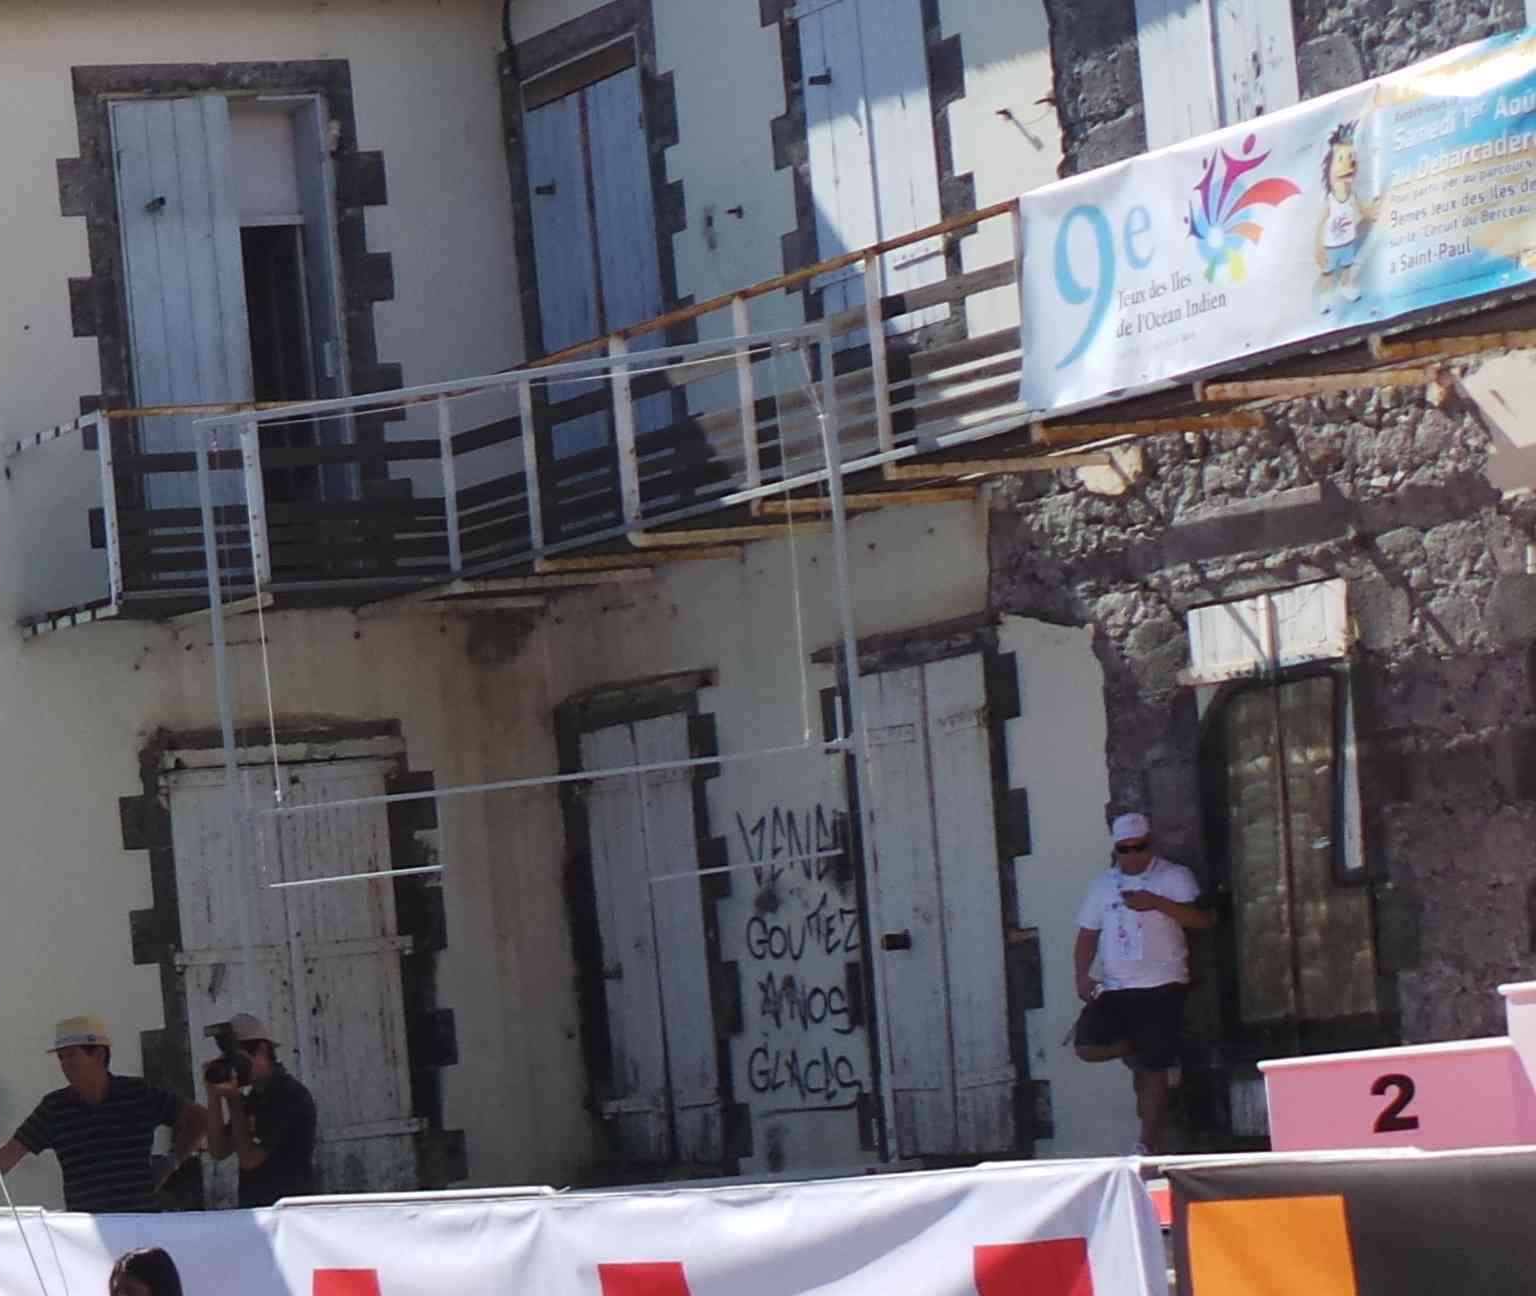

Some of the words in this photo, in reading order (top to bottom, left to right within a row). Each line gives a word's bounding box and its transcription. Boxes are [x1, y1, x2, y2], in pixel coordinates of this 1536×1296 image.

[1461, 191, 1486, 208] des
[1399, 234, 1473, 273] Saint-Paul
[1052, 204, 1156, 371] 9e
[1115, 319, 1134, 338] de
[1185, 291, 1228, 319] Indien
[1370, 1072, 1421, 1134] 2
